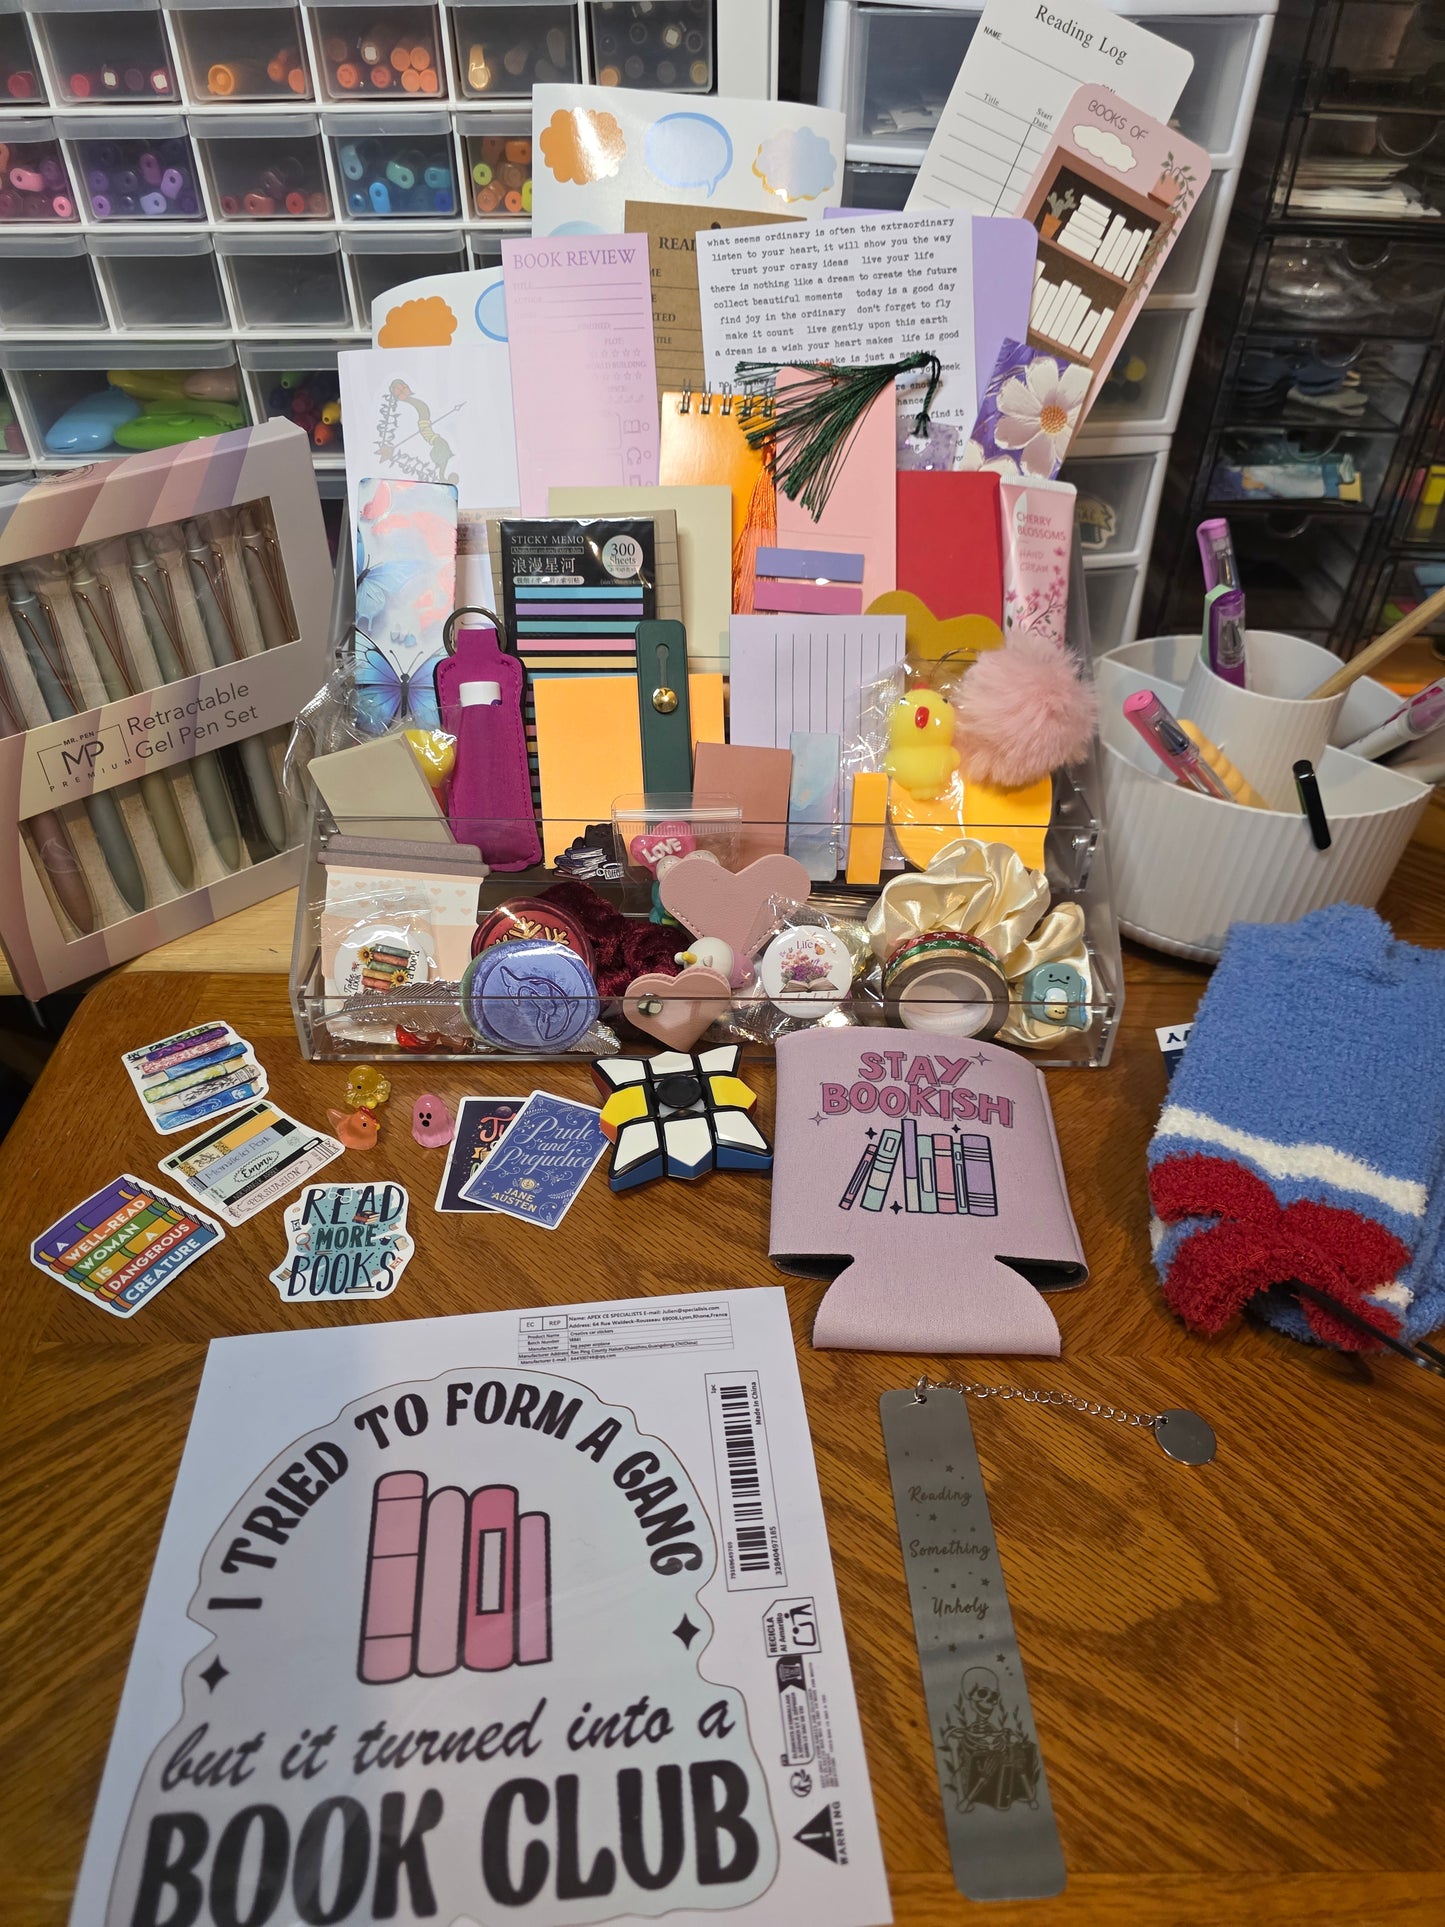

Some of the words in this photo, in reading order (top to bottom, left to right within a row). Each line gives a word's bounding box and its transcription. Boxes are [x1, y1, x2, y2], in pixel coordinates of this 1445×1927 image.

[983, 26, 1003, 41] NAME
[1035, 4, 1094, 48] Reading
[1098, 37, 1128, 66] Log
[983, 93, 1000, 106] Title
[1032, 117, 1049, 130] Date
[1036, 108, 1053, 121] Start
[1088, 99, 1127, 130] BOOKS
[1129, 125, 1149, 141] OF
[707, 238, 730, 246] what
[765, 231, 810, 241] ordinary
[881, 218, 954, 230] extraordinary
[513, 251, 563, 269] BOOK
[567, 249, 636, 266] REVIEW
[712, 253, 742, 261] listen
[762, 249, 784, 258] your
[790, 245, 819, 254] heart,
[824, 243, 833, 251] it
[838, 241, 859, 250] will
[891, 238, 907, 247] you
[934, 235, 951, 243] way
[731, 266, 757, 275] trust
[763, 265, 785, 274] your
[790, 262, 818, 270] crazy
[823, 259, 848, 267] ideas
[862, 256, 881, 264] live
[887, 254, 909, 264] your
[915, 251, 934, 260] life
[753, 280, 789, 289] nothing
[873, 271, 902, 279] create
[927, 267, 957, 275] future
[714, 299, 748, 309] collect
[752, 294, 800, 305] beautiful
[805, 292, 842, 301] moments
[856, 288, 882, 297] today
[913, 283, 933, 294] good
[939, 283, 955, 292] day
[721, 315, 741, 325] find
[746, 315, 760, 324] joy
[801, 309, 846, 318] ordinary
[857, 304, 880, 313] don't
[885, 302, 916, 312] forget
[936, 299, 951, 308] fly
[725, 331, 748, 340] make
[767, 328, 794, 336] count
[807, 326, 826, 334] live
[832, 322, 863, 333] gently
[868, 321, 890, 330] upon
[896, 318, 915, 326] this
[920, 315, 948, 324] earth
[808, 342, 829, 351] your
[834, 339, 861, 347] heart
[902, 334, 920, 342] life
[939, 330, 959, 341] good
[850, 353, 860, 362] is
[865, 352, 885, 364] just
[1016, 512, 1052, 526] CHERRY
[511, 536, 548, 544] STICKY
[552, 536, 584, 544] MEMO
[1018, 526, 1066, 541] BLOSSOMS
[610, 555, 636, 565] Sheets
[612, 543, 636, 557] 300
[1020, 550, 1044, 560] HAND
[512, 557, 575, 573] 浪漫星河
[1020, 562, 1049, 574] CREAM
[127, 683, 250, 736] Retractable
[63, 738, 78, 746] MR.
[80, 731, 94, 740] PEN
[135, 731, 174, 760] Gel
[179, 721, 219, 744] Pen
[226, 706, 259, 728] Set
[49, 758, 133, 792] PREMIUM
[642, 838, 682, 863] LOVE
[796, 938, 814, 950] Life
[859, 1051, 972, 1086] STAY
[821, 1082, 1014, 1128] BOOKISH
[514, 1116, 595, 1148] Pride
[537, 1138, 575, 1153] and
[241, 1156, 273, 1178] Emma
[486, 1146, 594, 1176] Prejudice
[246, 1167, 301, 1206] PERSUASION
[504, 1188, 535, 1202] JANE
[302, 1185, 404, 1225] READ
[491, 1193, 537, 1213] AUSTEN
[65, 1200, 146, 1261] WELL-READ
[315, 1224, 379, 1250] MORE
[56, 1241, 69, 1252] A
[78, 1222, 140, 1270] WOMAN
[96, 1266, 113, 1280] IS
[145, 1231, 158, 1241] A
[108, 1223, 190, 1291] DANGEROUS
[125, 1238, 200, 1301] CREATURE
[288, 1251, 396, 1296] BOOKS
[354, 1392, 429, 1451] TO
[446, 1380, 583, 1440] FORM
[575, 1417, 623, 1464] A
[222, 1440, 350, 1576] TRIED
[908, 1486, 972, 1506] Reading
[612, 1448, 704, 1578] GANG
[909, 1540, 991, 1561] Something
[207, 1596, 263, 1610] I
[932, 1597, 989, 1620] Unholy
[767, 1616, 778, 1652] RECICLA
[778, 1612, 786, 1642] Amarillo
[160, 1723, 265, 1792] but
[280, 1725, 338, 1781] it
[351, 1698, 548, 1776] turned
[566, 1695, 675, 1754] into
[697, 1699, 737, 1739] a
[130, 1788, 445, 1927] BOOK
[482, 1759, 760, 1907] CLUB
[832, 1801, 848, 1866] WARNING
